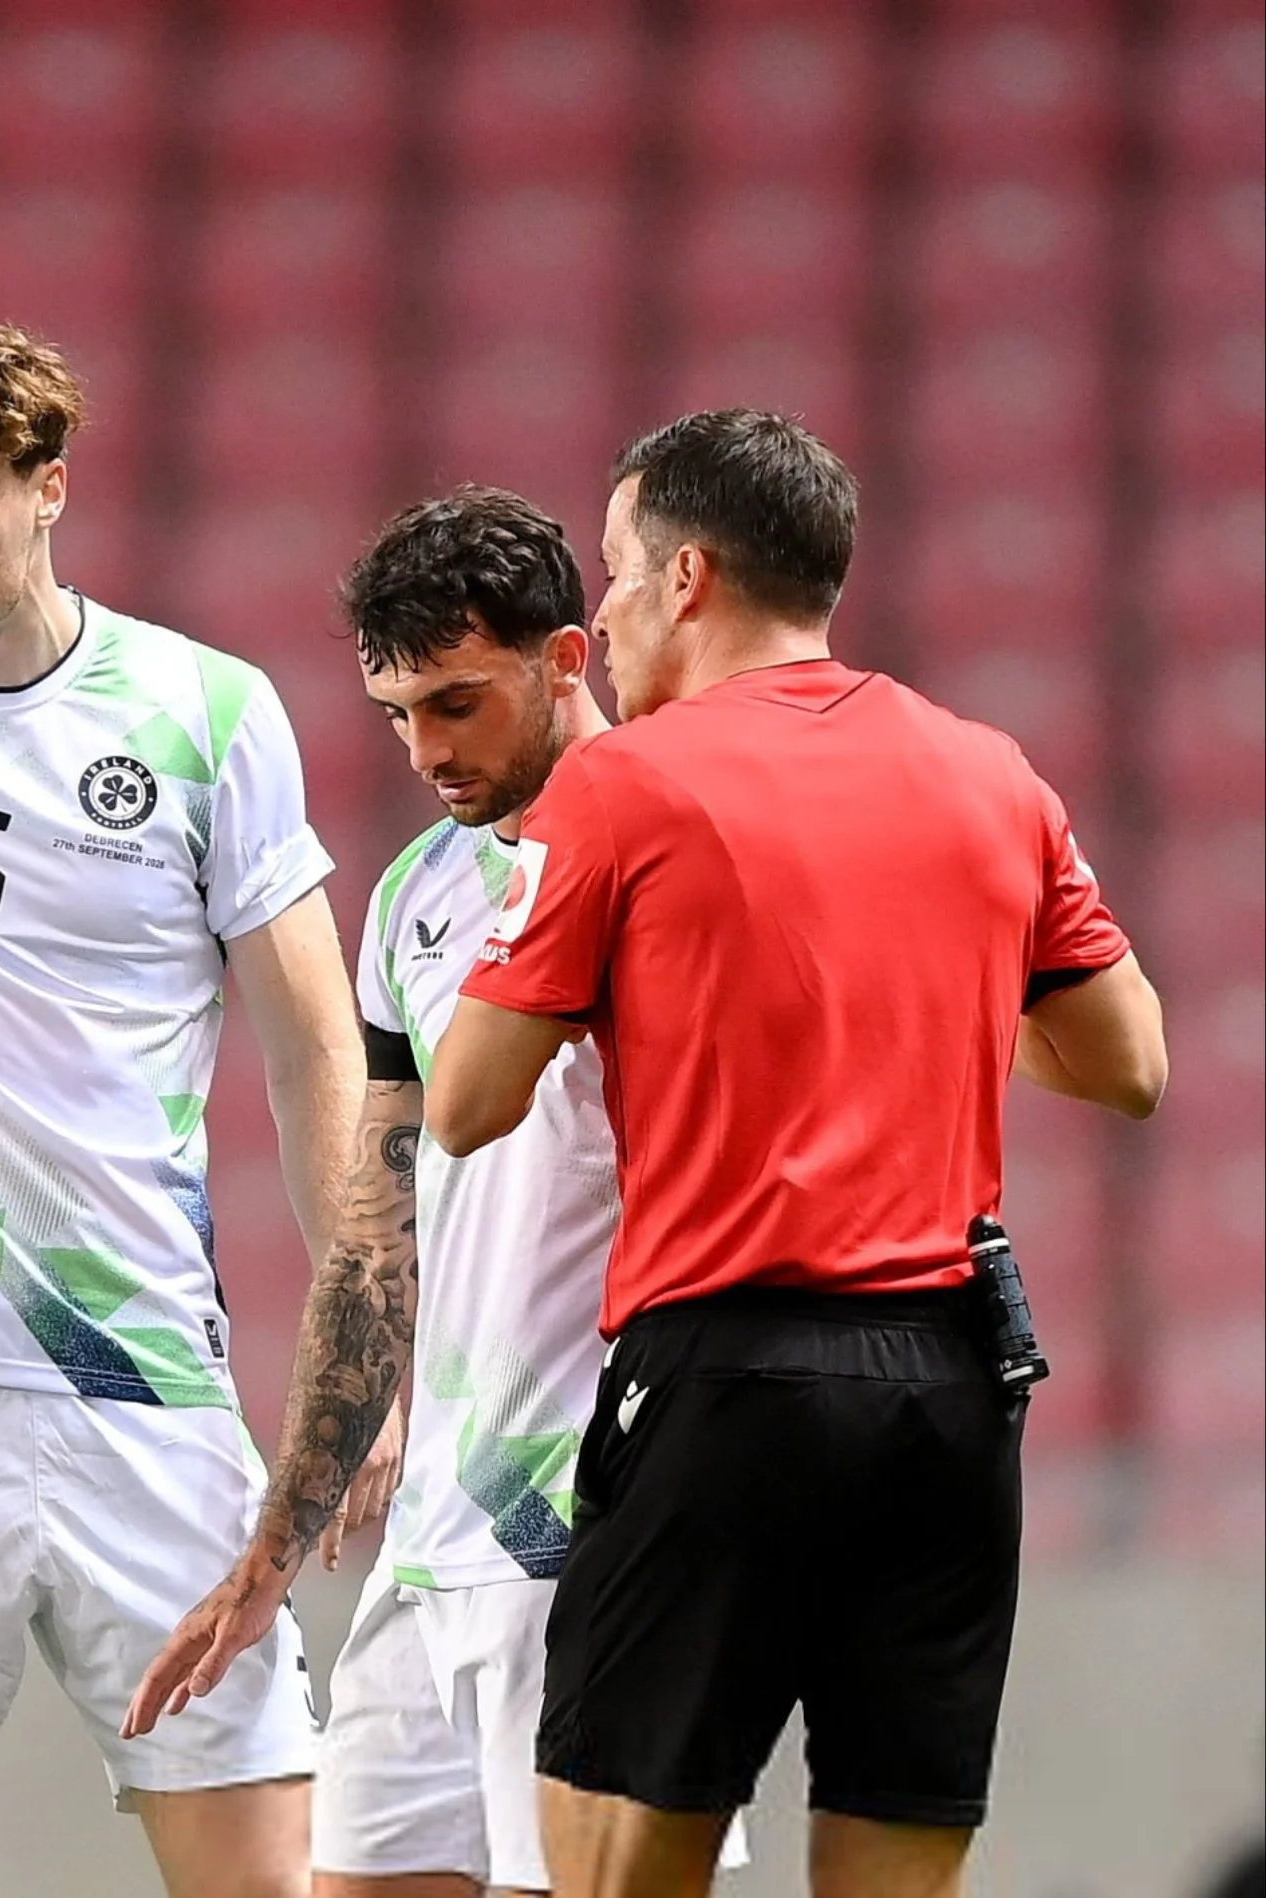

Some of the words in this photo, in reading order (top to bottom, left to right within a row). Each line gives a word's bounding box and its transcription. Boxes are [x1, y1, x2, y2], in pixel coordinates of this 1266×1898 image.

[84, 758, 152, 785] IRELAND
[52, 838, 75, 851] 27th
[78, 844, 143, 865] SEPTEMBER
[84, 833, 143, 853] DEBRECEN
